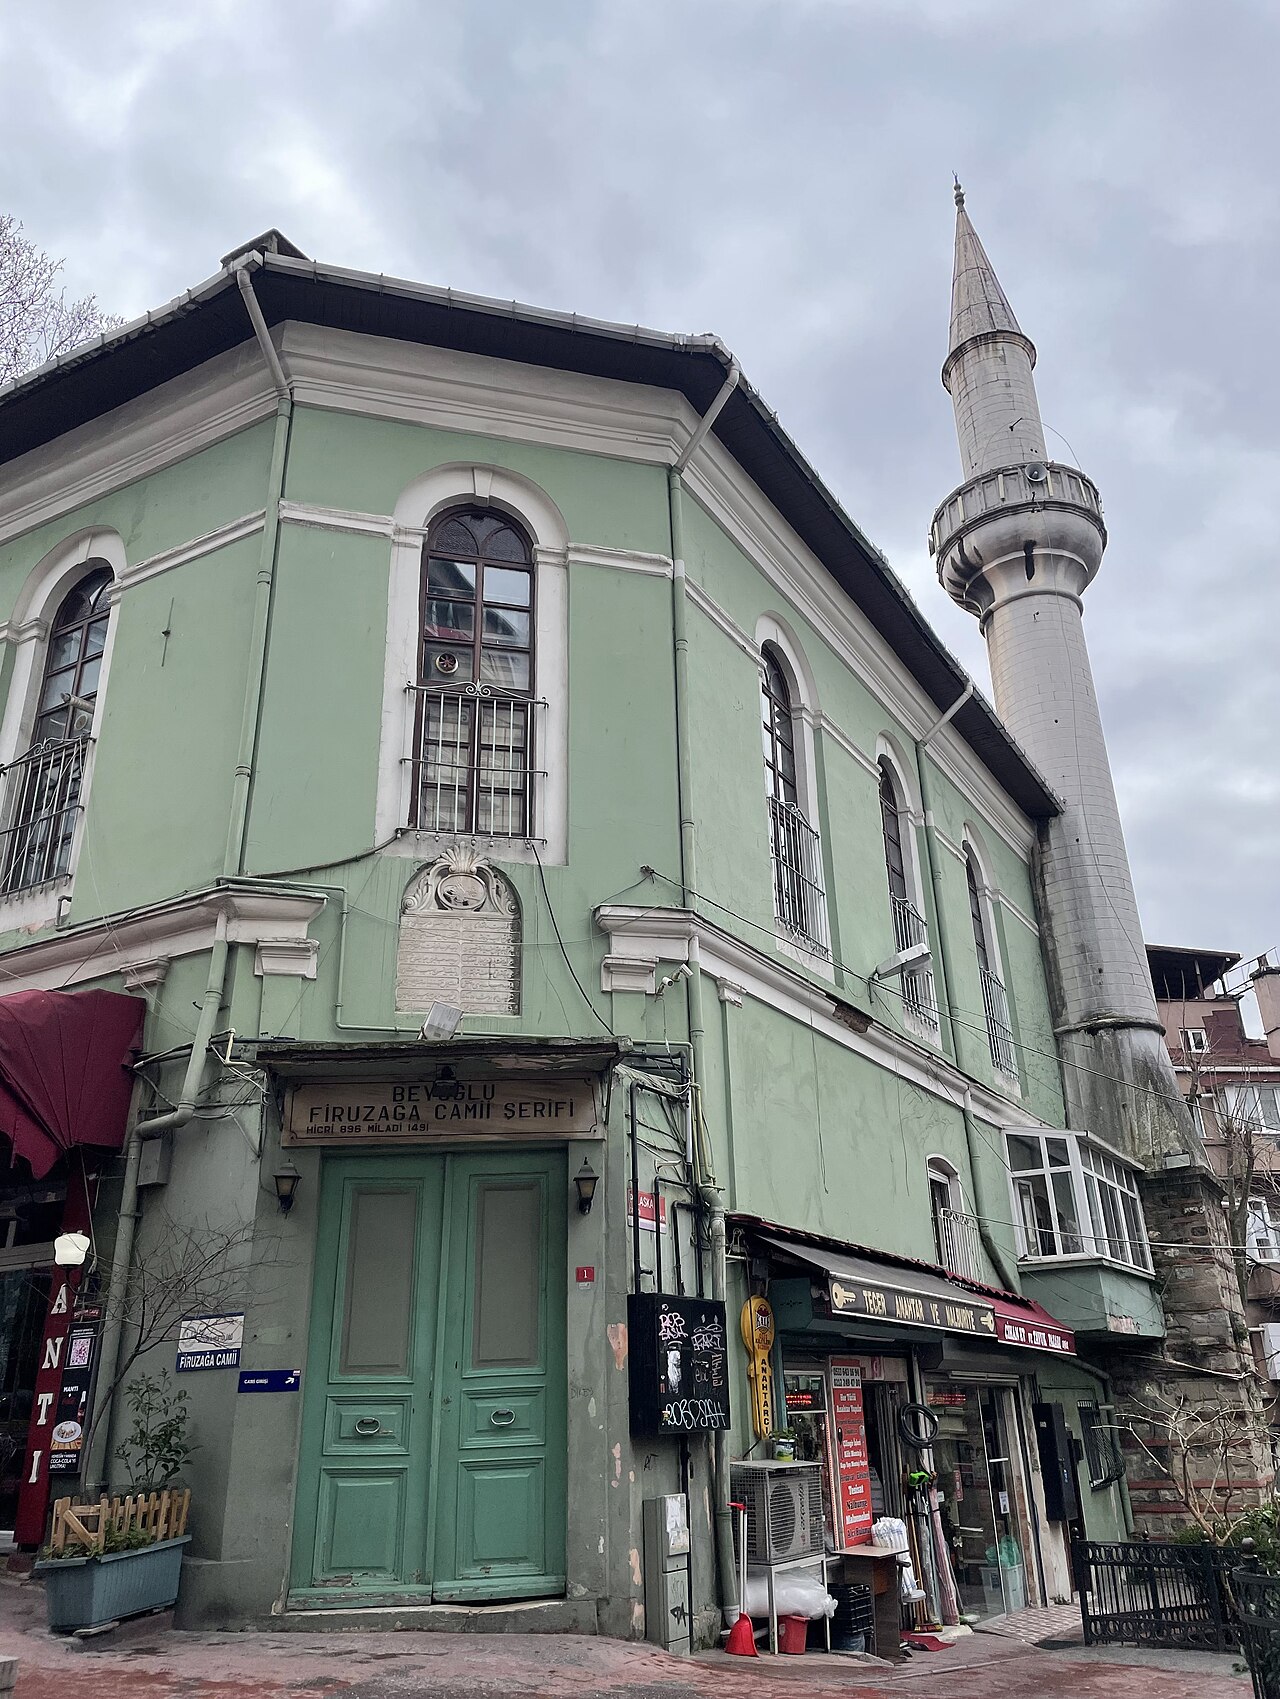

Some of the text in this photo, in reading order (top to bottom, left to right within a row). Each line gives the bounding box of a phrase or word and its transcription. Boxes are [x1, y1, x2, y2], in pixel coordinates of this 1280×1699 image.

[309, 1098, 574, 1123] FİRUZAĞA CAMİİ ŞERİFİ
[306, 1122, 429, 1135] HİCRİ 896 MİLADİ 1491
[582, 1269, 588, 1279] 1
[895, 1295, 925, 1322] ANAHTAR
[930, 1302, 941, 1325] VE
[179, 1349, 238, 1369] FİRUZAĞA CAMİİ
[760, 1358, 770, 1435] ANAHTARCI
